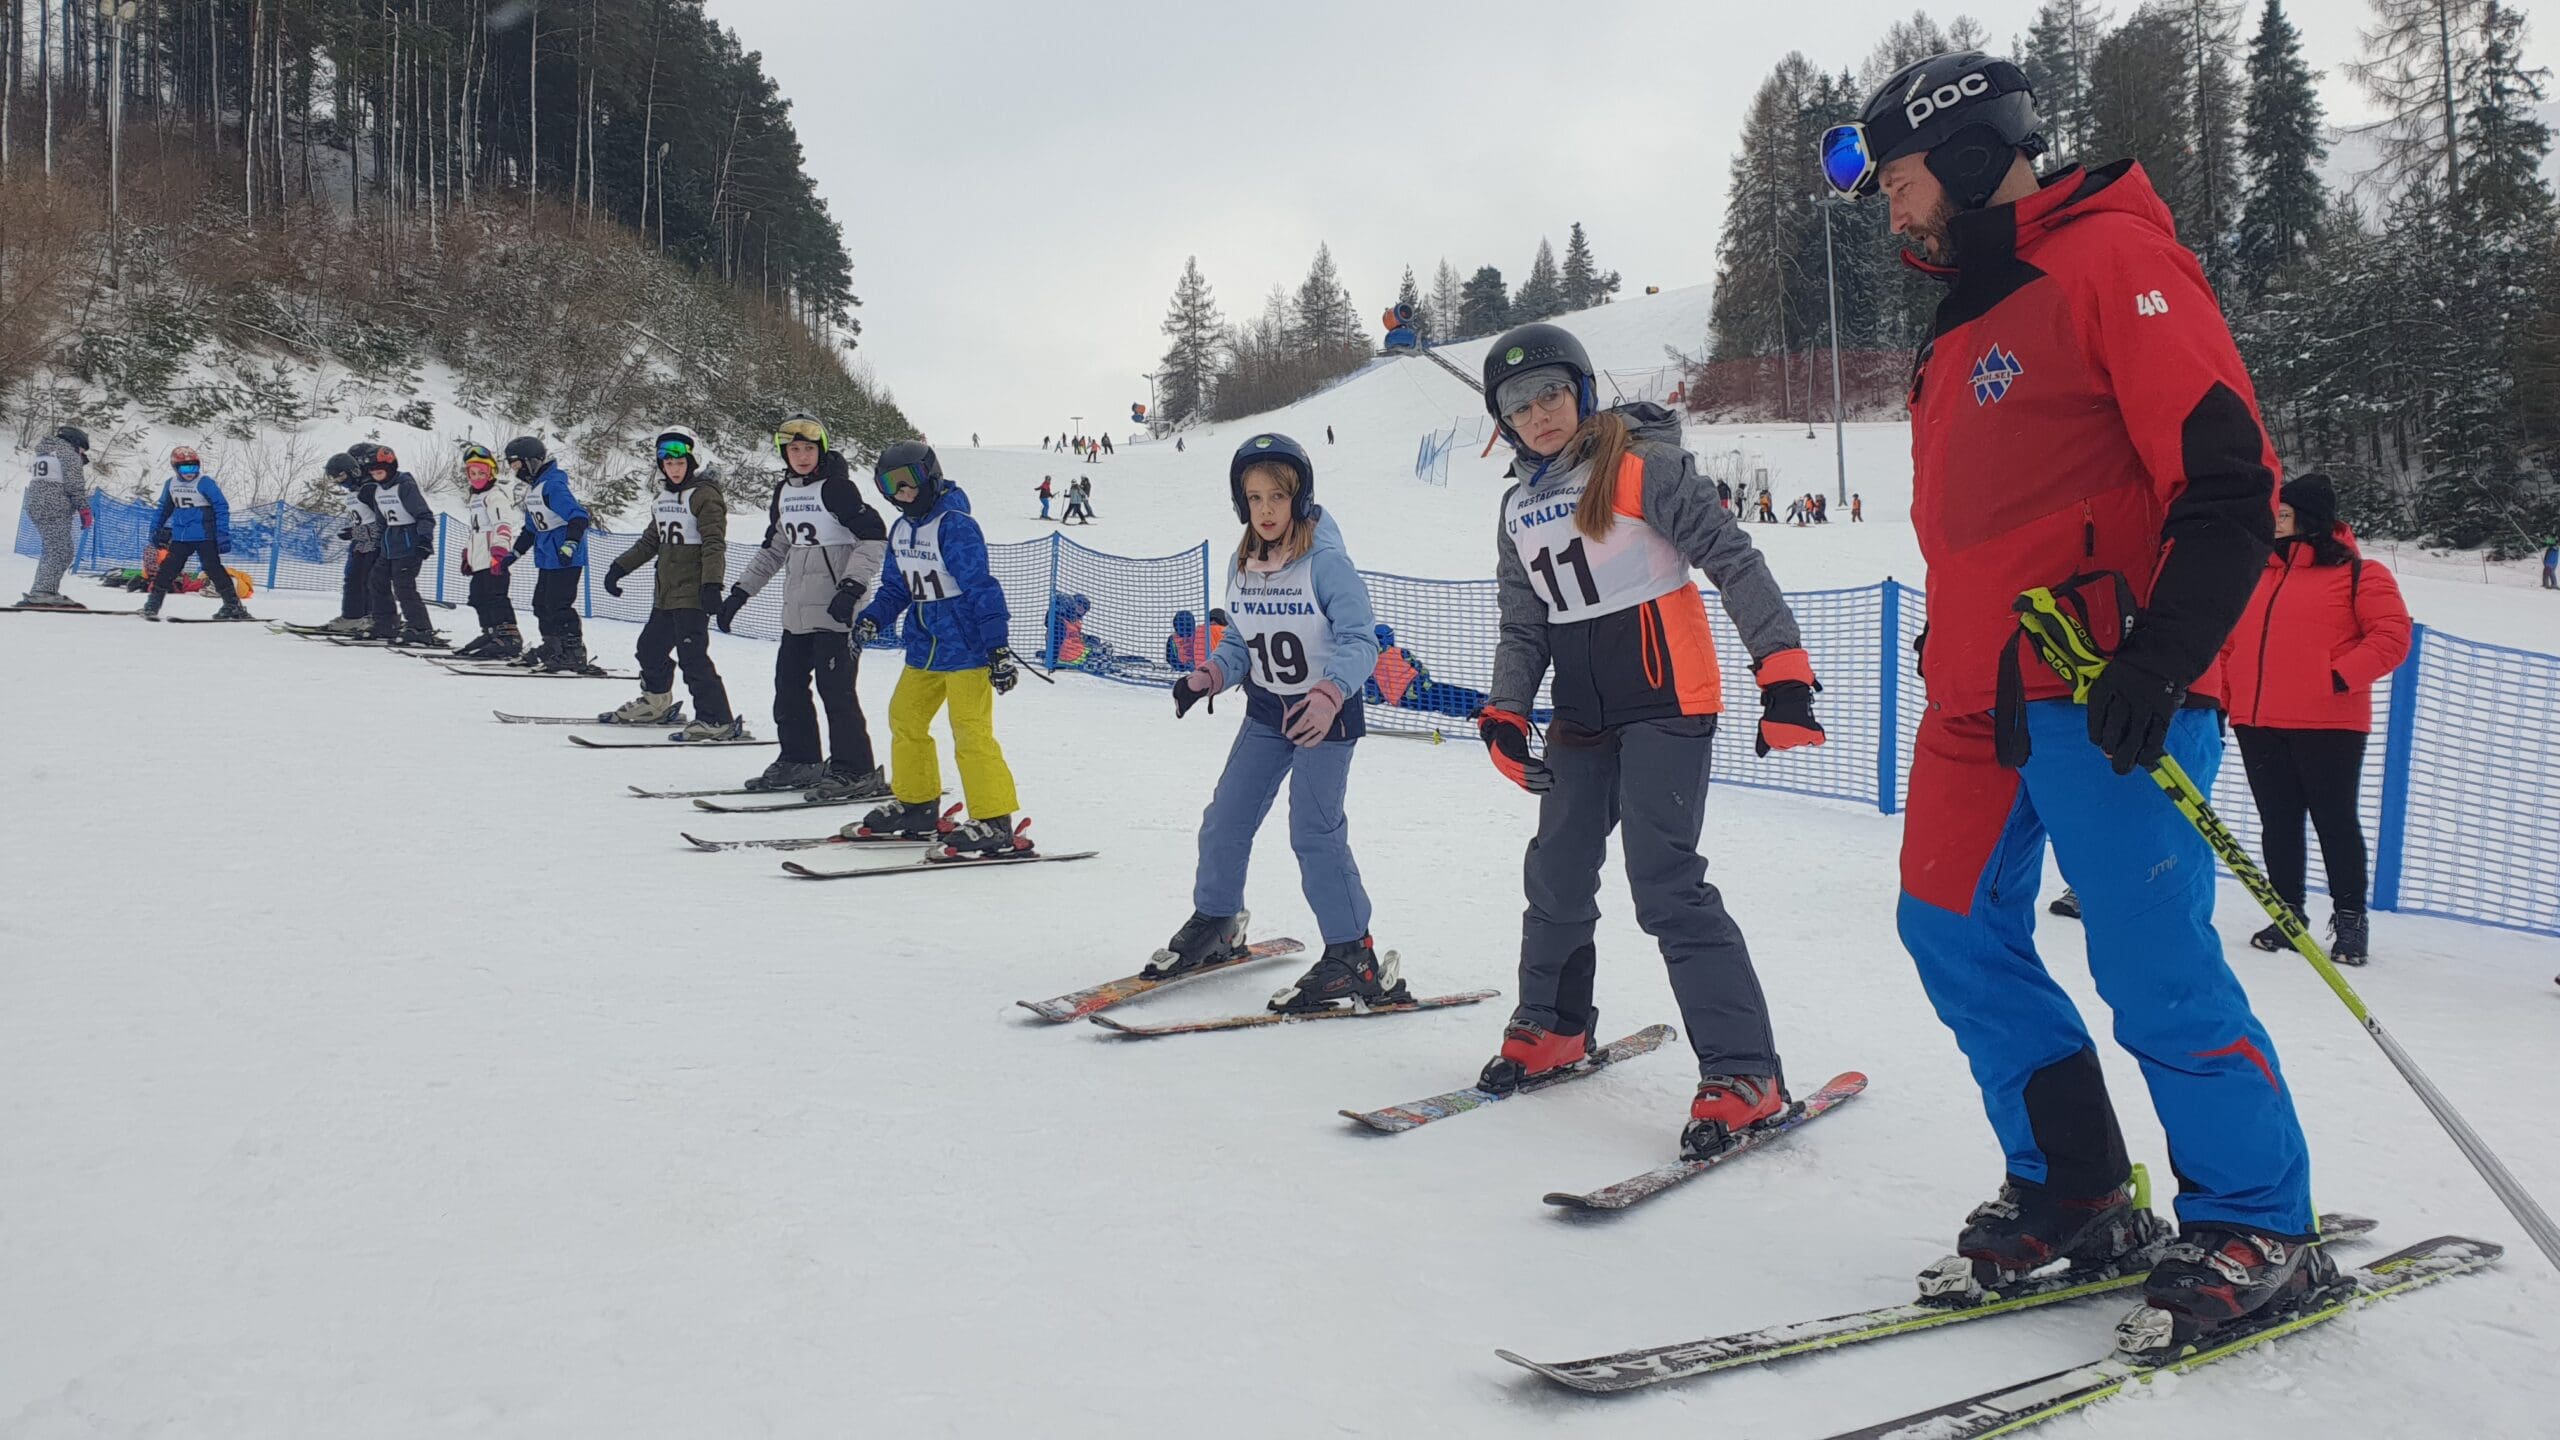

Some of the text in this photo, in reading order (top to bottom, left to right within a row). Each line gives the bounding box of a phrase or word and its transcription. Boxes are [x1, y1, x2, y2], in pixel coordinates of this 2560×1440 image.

[2136, 290, 2168, 316] 46
[1508, 502, 1577, 534] U WALUS
[658, 521, 684, 545] 56
[785, 522, 819, 546] 23
[1530, 536, 1600, 612] 11
[1231, 602, 1315, 616] U WALUSIA
[1246, 631, 1309, 685] 19
